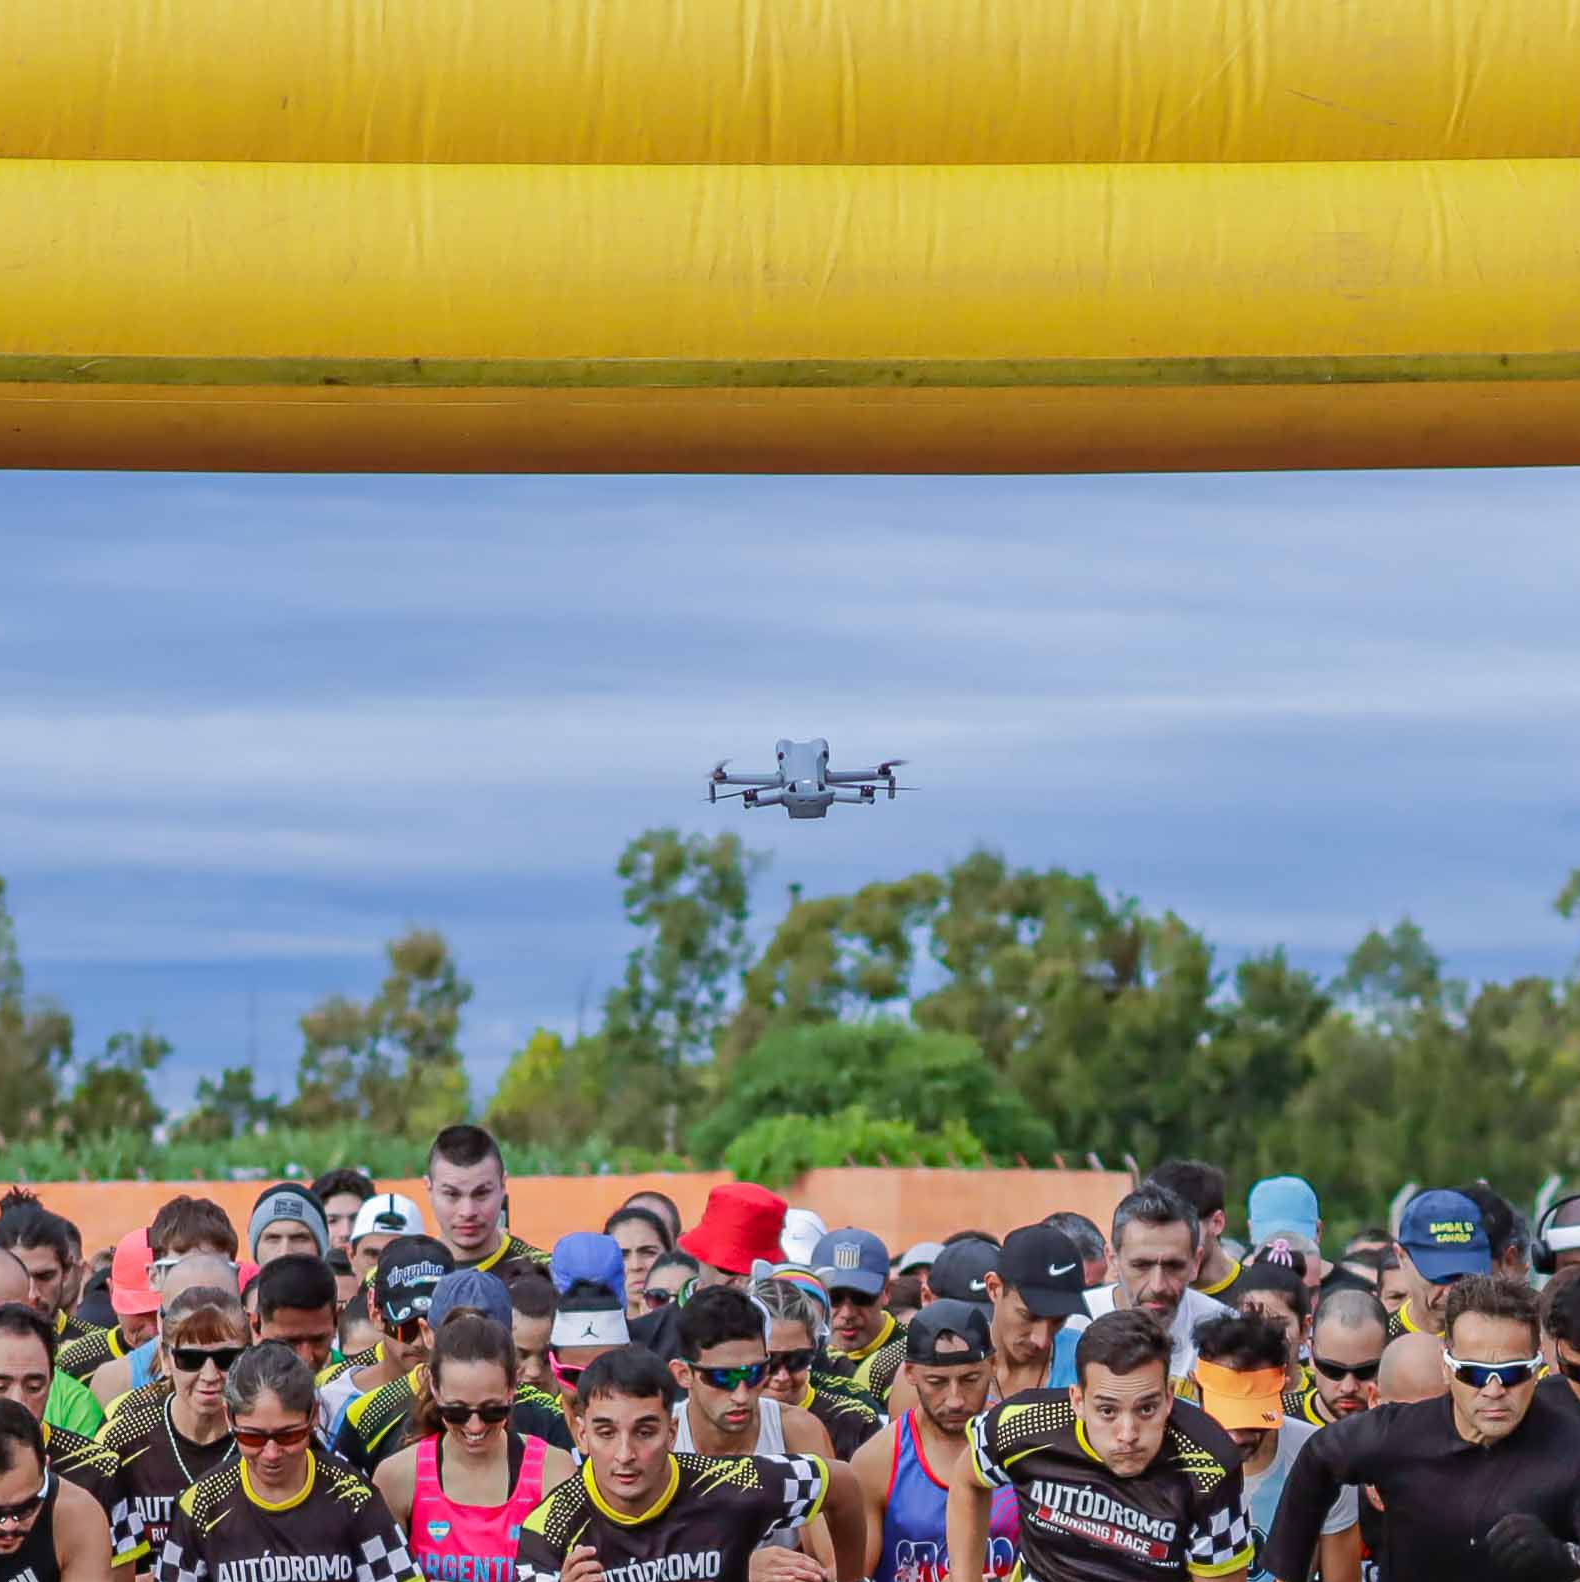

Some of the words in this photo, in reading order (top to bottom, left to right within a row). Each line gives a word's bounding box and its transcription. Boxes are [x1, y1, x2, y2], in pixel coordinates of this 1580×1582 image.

[1030, 1480, 1177, 1542] AUTÓDROMO
[1049, 1509, 1111, 1541] RUNNING
[1113, 1529, 1152, 1556] RACE
